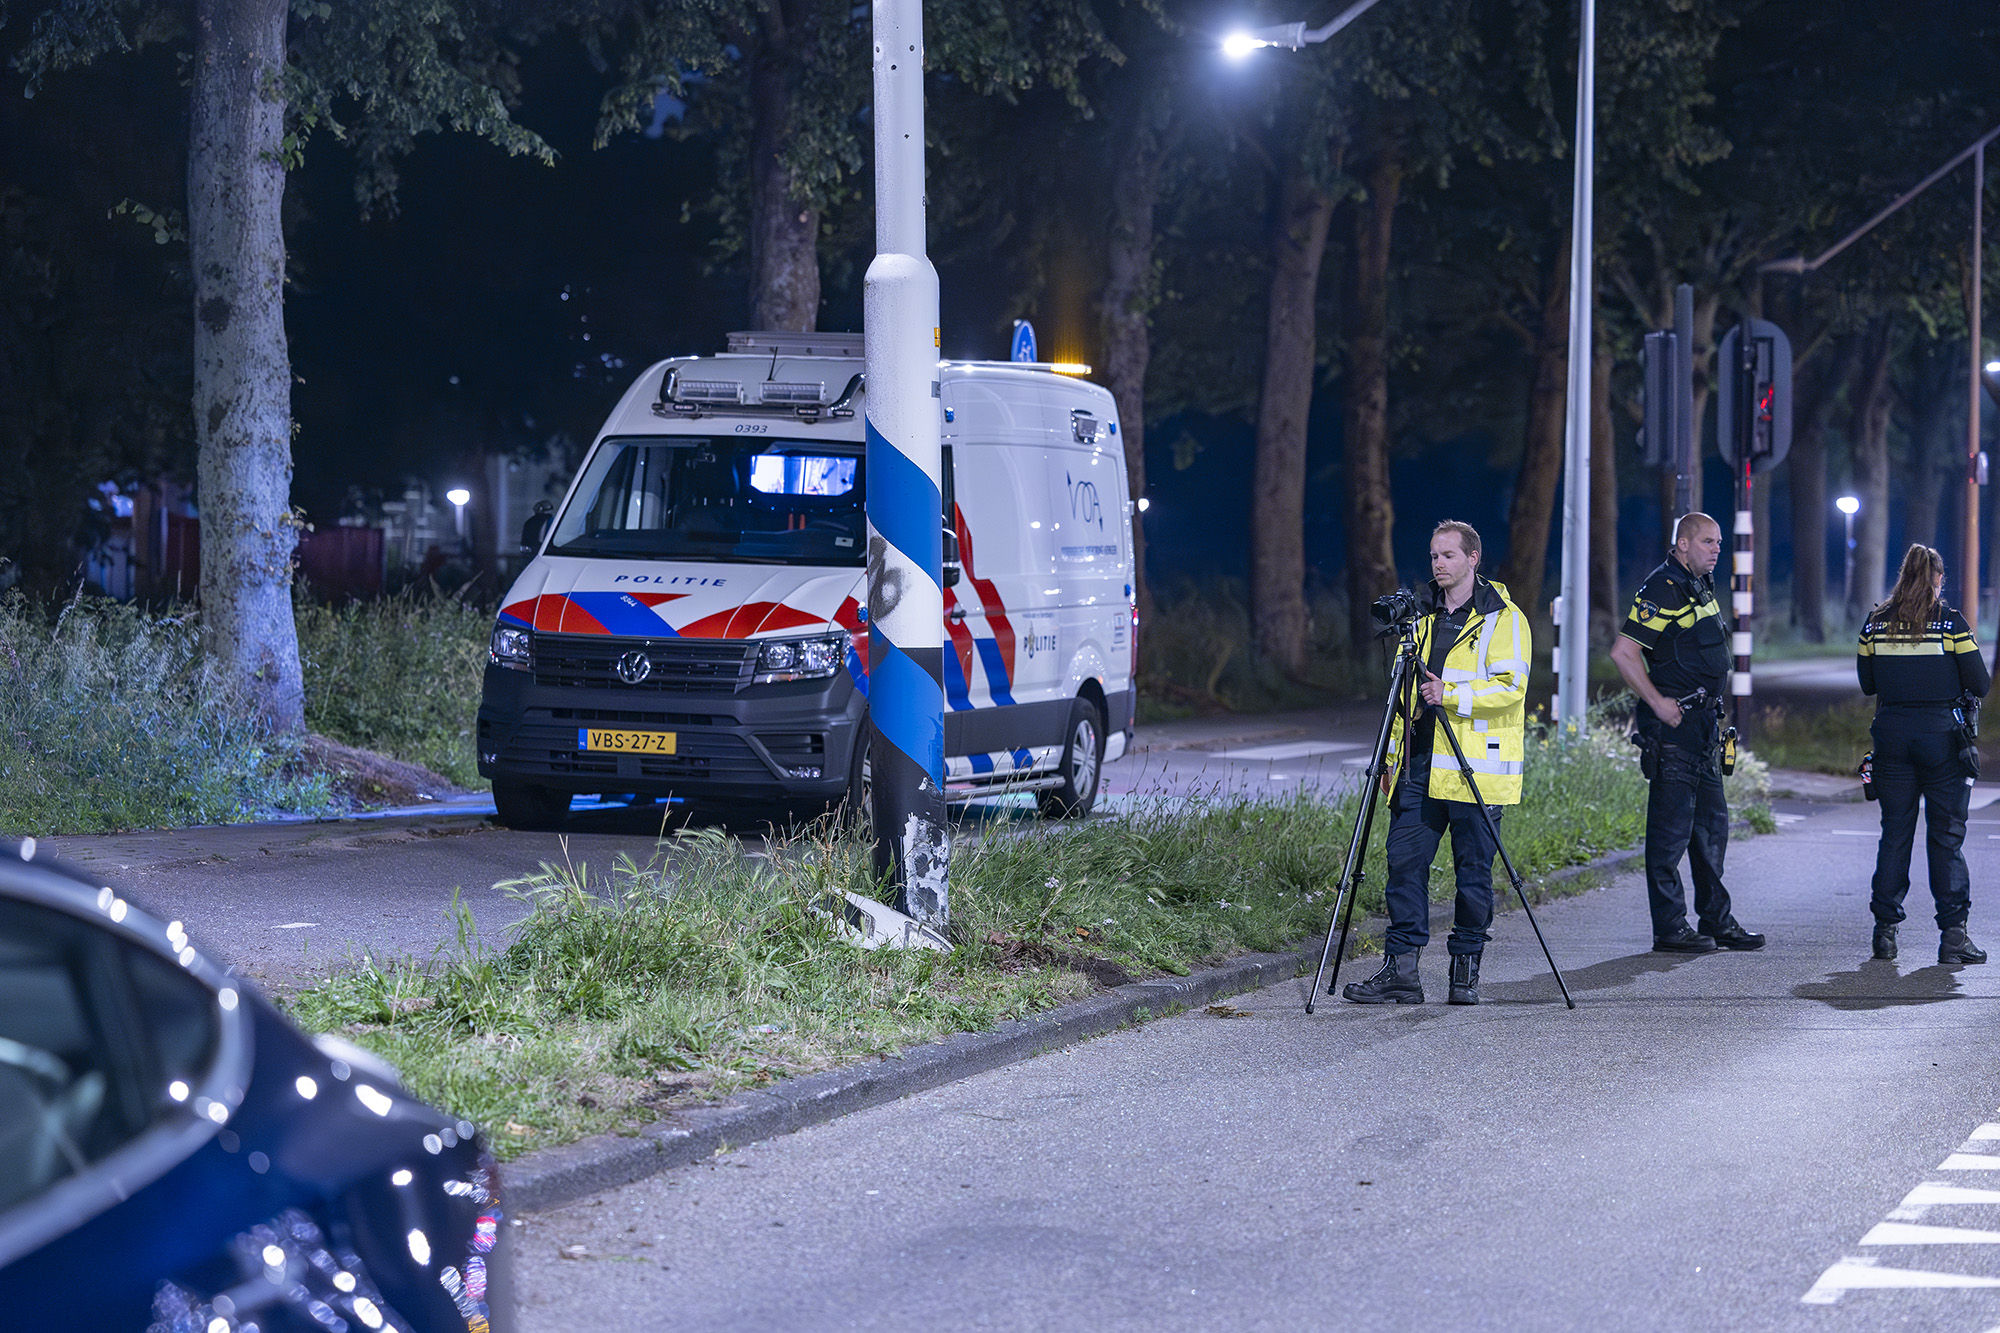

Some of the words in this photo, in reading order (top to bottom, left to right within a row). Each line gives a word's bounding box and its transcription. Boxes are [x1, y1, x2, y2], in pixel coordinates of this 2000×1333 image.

[734, 424, 768, 434] 0393
[614, 575, 727, 587] POLITIE
[592, 732, 666, 750] VBS-27-Z
